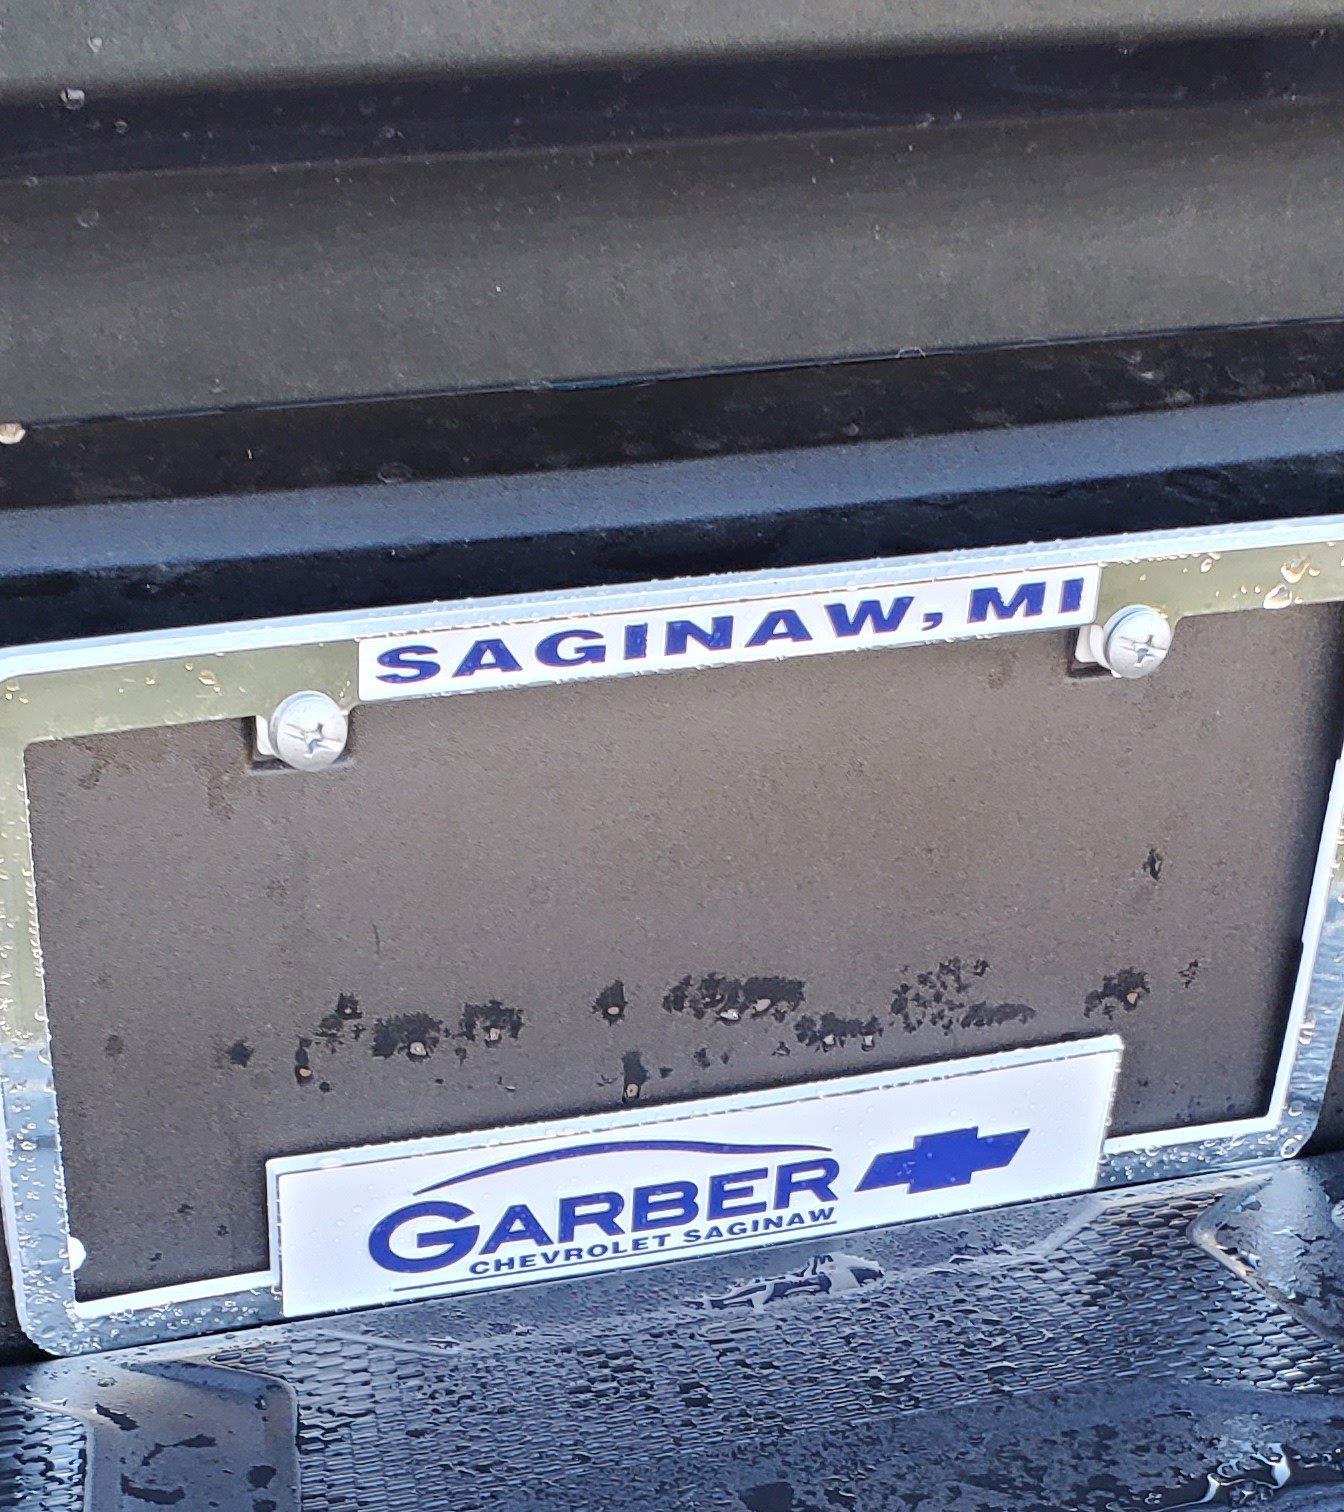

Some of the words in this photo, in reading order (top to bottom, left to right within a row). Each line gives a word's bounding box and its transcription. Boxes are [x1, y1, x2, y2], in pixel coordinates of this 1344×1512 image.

[367, 1156, 841, 1274] GARBER
[467, 1233, 671, 1276] CHEVROLET
[683, 1206, 837, 1247] SAGINAW
